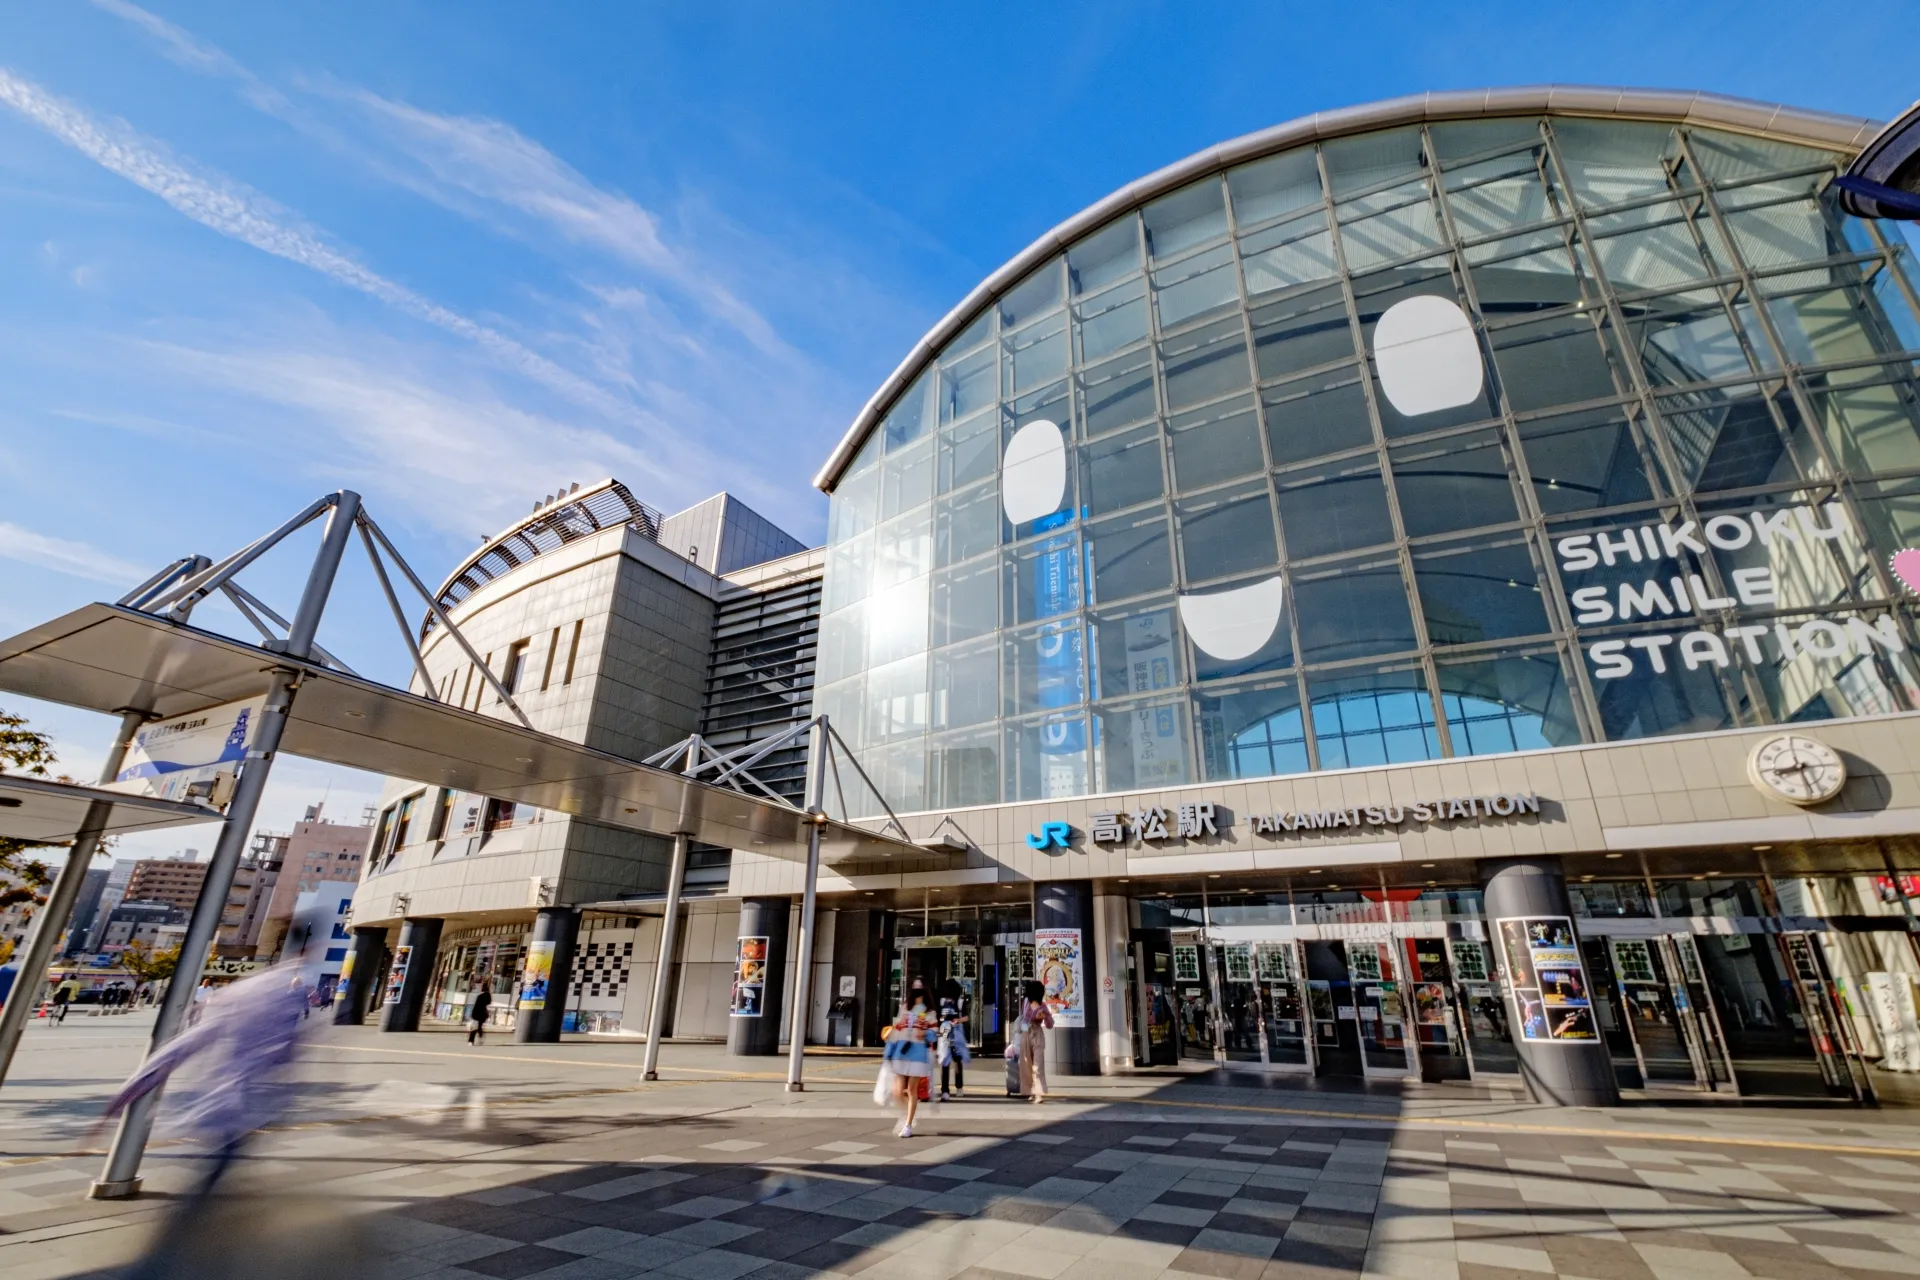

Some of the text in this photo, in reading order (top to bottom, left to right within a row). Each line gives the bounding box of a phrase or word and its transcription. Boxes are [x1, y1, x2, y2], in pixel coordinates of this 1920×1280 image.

[1558, 502, 1846, 571] SHIKOKU
[1572, 567, 1779, 624] SMILE
[1589, 614, 1905, 680] STATION
[1025, 821, 1071, 850] JR
[1088, 801, 1218, 845] 高松駅
[1242, 791, 1541, 833] TAKAMATSU STATION
